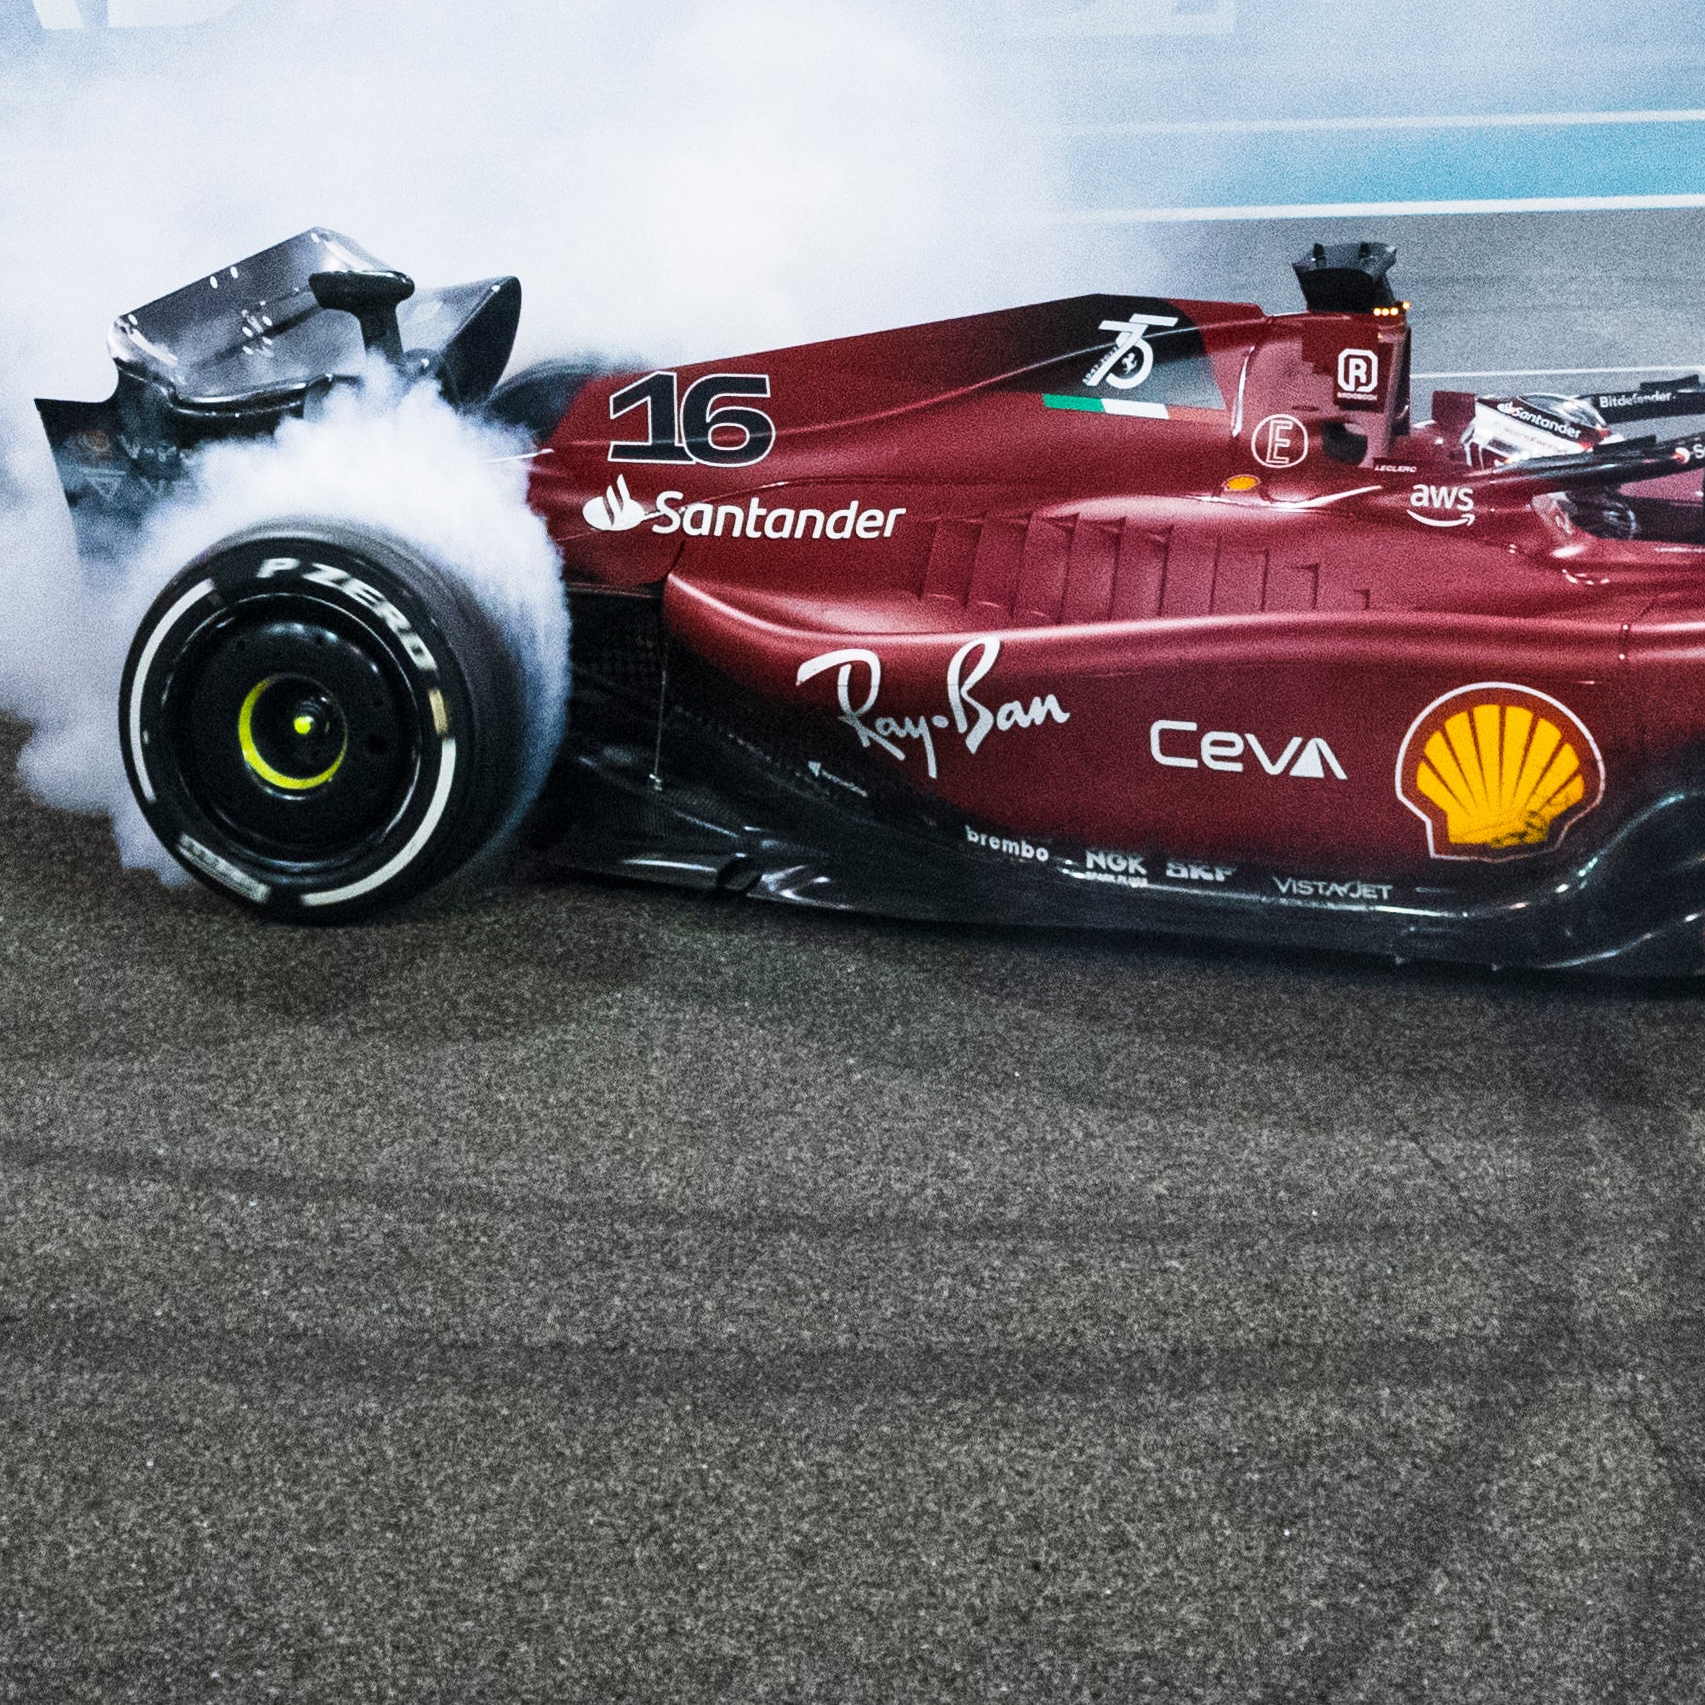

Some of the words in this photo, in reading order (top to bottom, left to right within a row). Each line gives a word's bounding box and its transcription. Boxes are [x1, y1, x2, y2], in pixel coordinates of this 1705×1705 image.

[607, 370, 777, 468] 16
[1513, 407, 1582, 439] Santander
[651, 489, 907, 540] Santander
[1410, 482, 1475, 512] aws
[256, 557, 301, 579] P
[303, 562, 438, 672] ZERO
[796, 635, 1071, 779] Ray-Ban
[964, 823, 1050, 862] brembo
[1086, 850, 1147, 875] NGK
